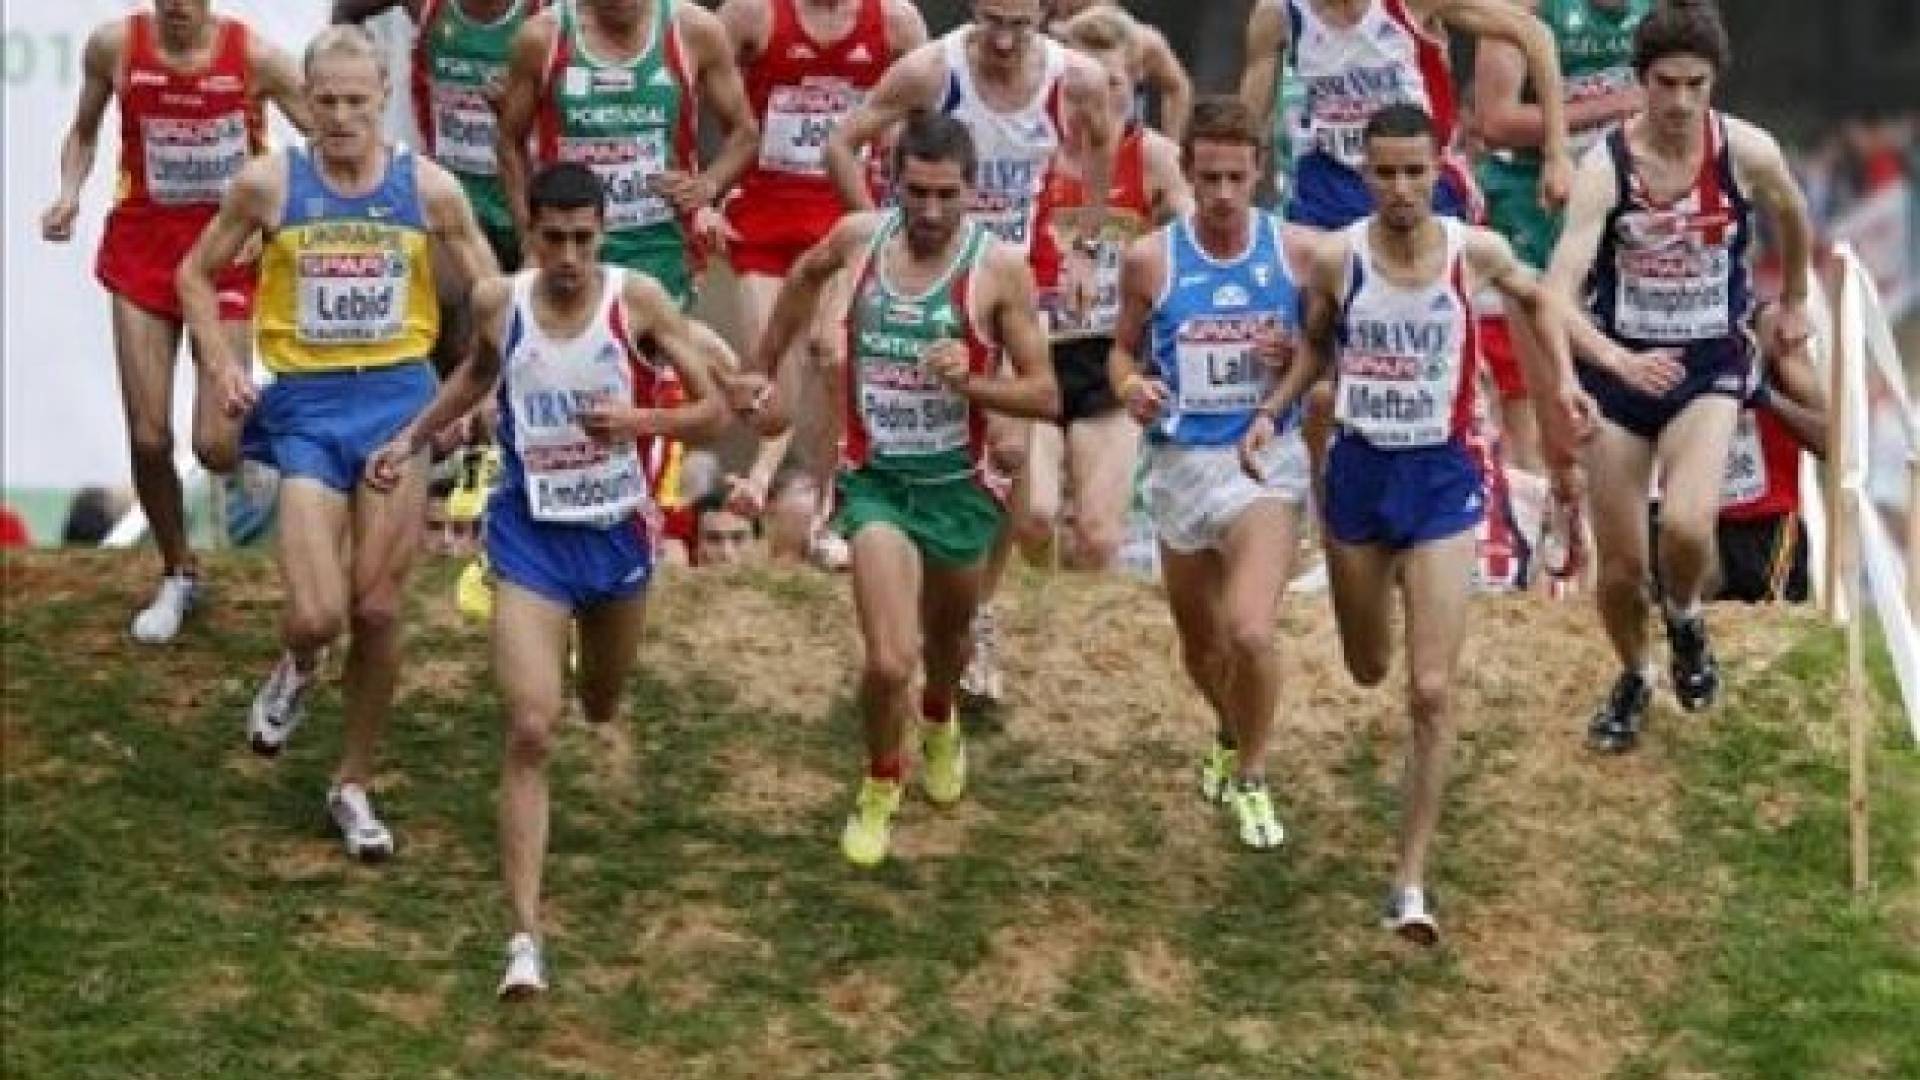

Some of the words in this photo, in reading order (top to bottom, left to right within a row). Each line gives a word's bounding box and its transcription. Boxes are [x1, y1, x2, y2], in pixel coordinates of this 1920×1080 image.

[569, 106, 667, 126] PORTUGAL
[316, 284, 393, 321] Lebid
[865, 392, 918, 428] Pedro
[1348, 384, 1434, 421] Meftah
